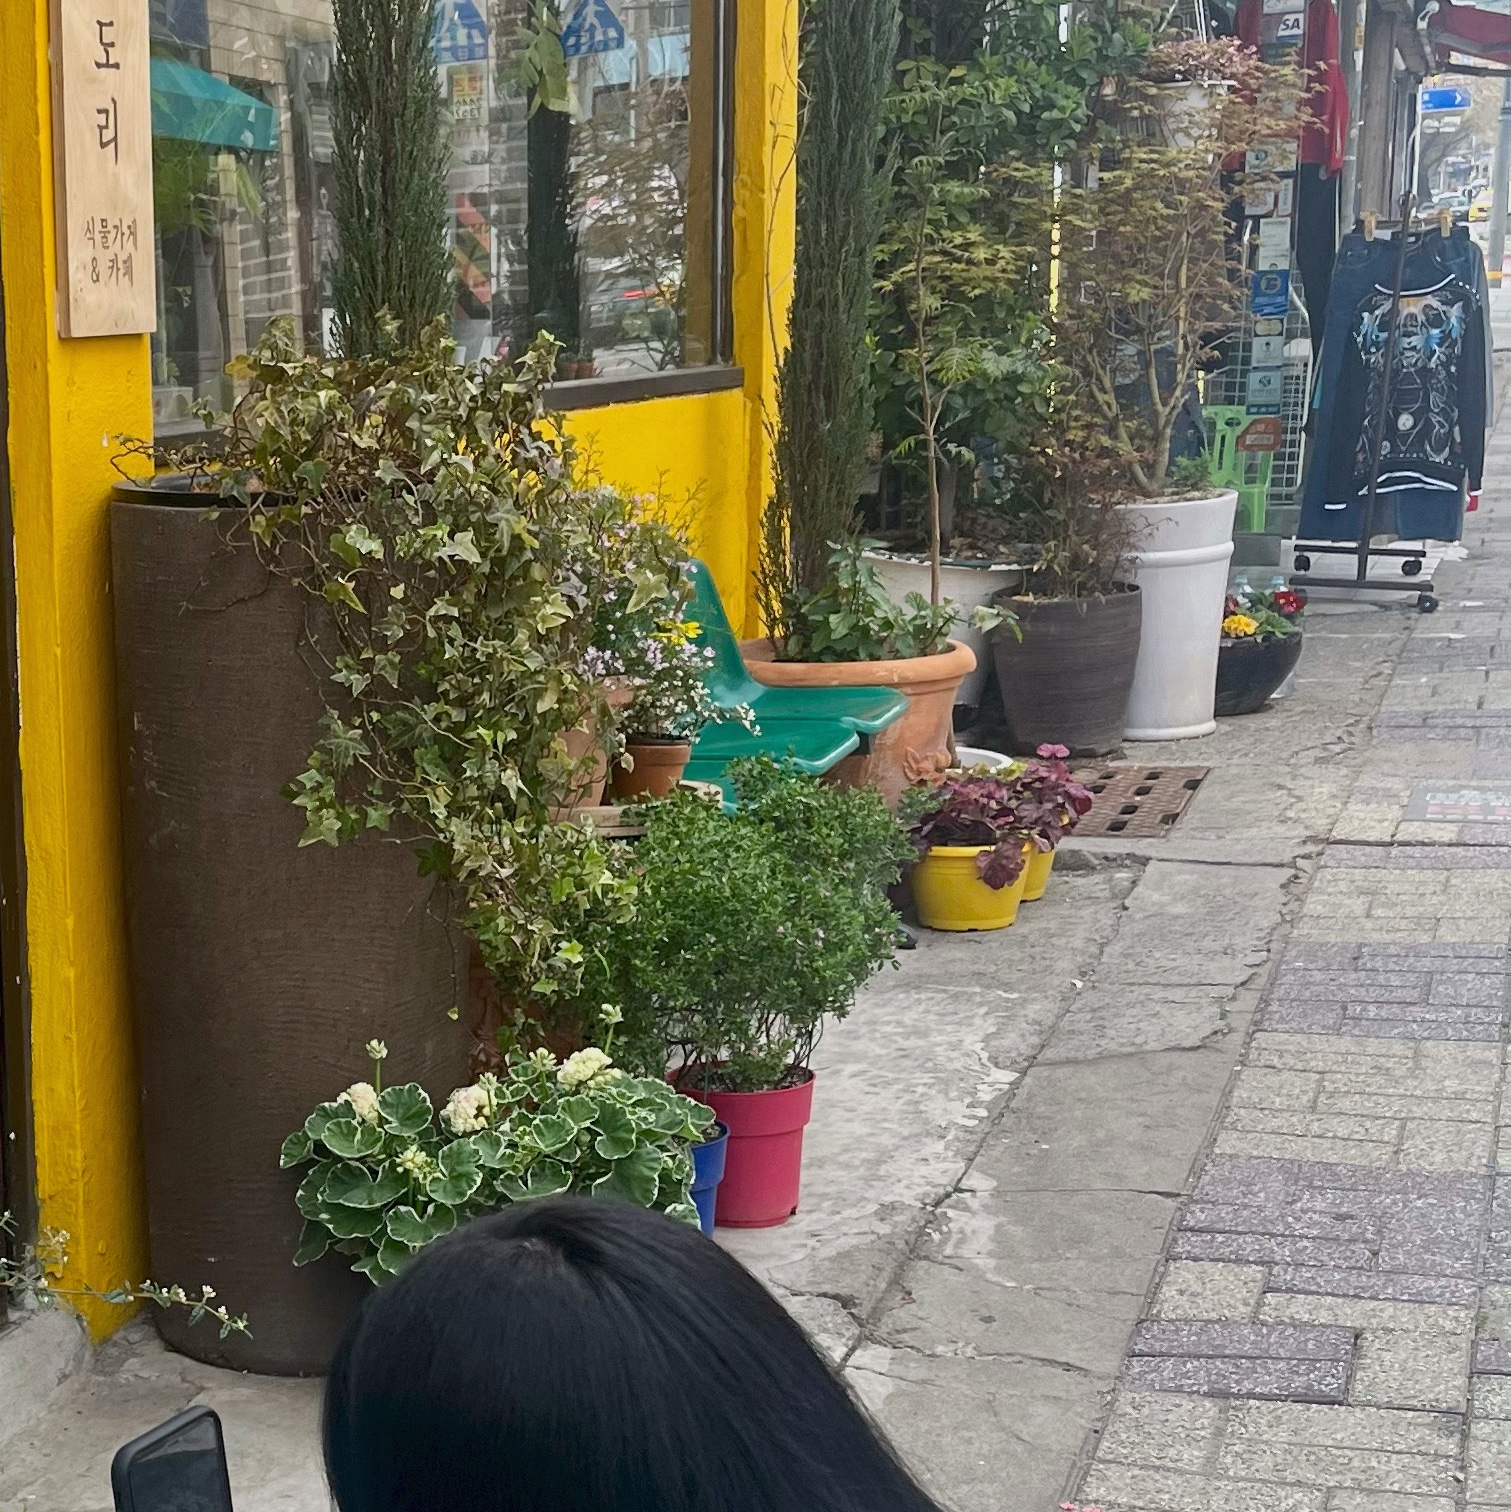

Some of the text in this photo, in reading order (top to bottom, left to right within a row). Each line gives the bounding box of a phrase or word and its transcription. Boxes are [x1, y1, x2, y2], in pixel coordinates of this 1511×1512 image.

[83, 215, 138, 252] 식물가게
[90, 252, 134, 288] & 카페
